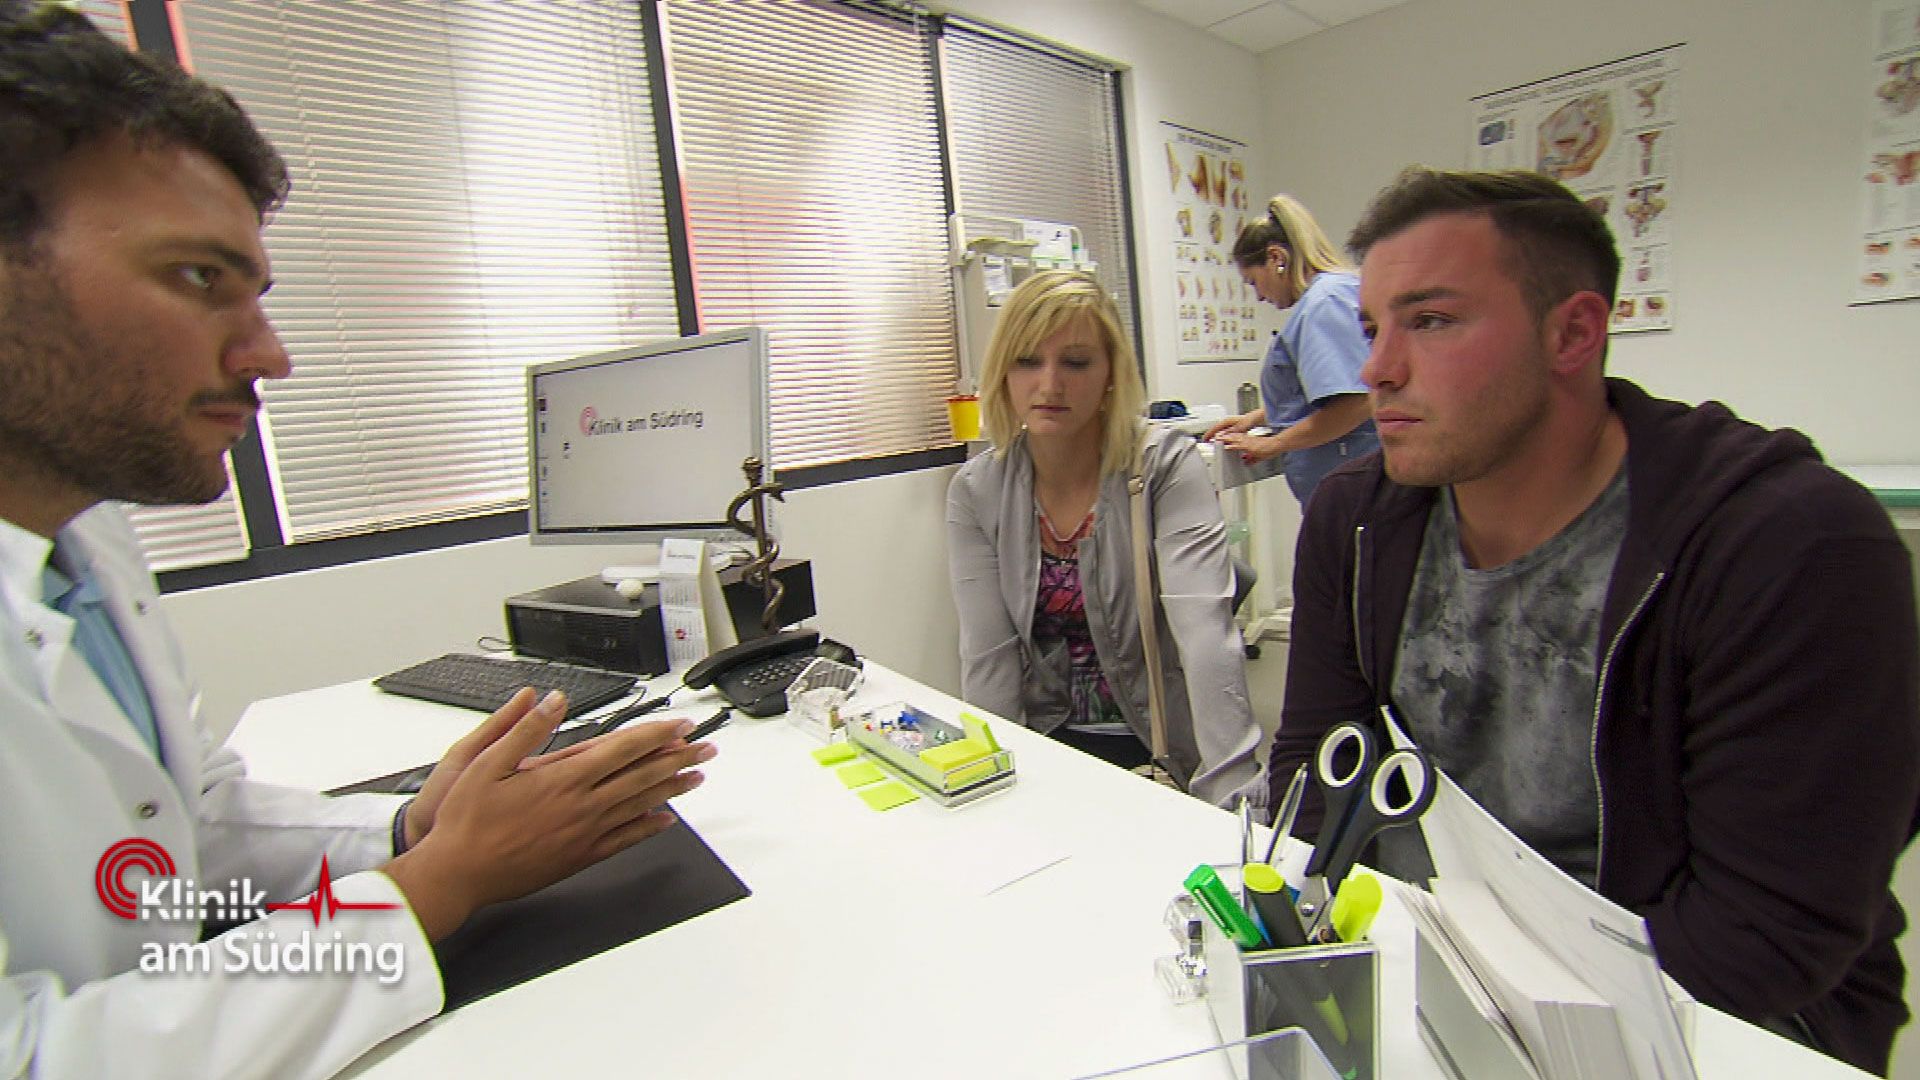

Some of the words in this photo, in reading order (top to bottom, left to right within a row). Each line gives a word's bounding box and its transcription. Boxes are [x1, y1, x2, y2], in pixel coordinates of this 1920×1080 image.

[589, 417, 622, 436] Klinik
[626, 418, 647, 432] am
[650, 409, 704, 430] Südring
